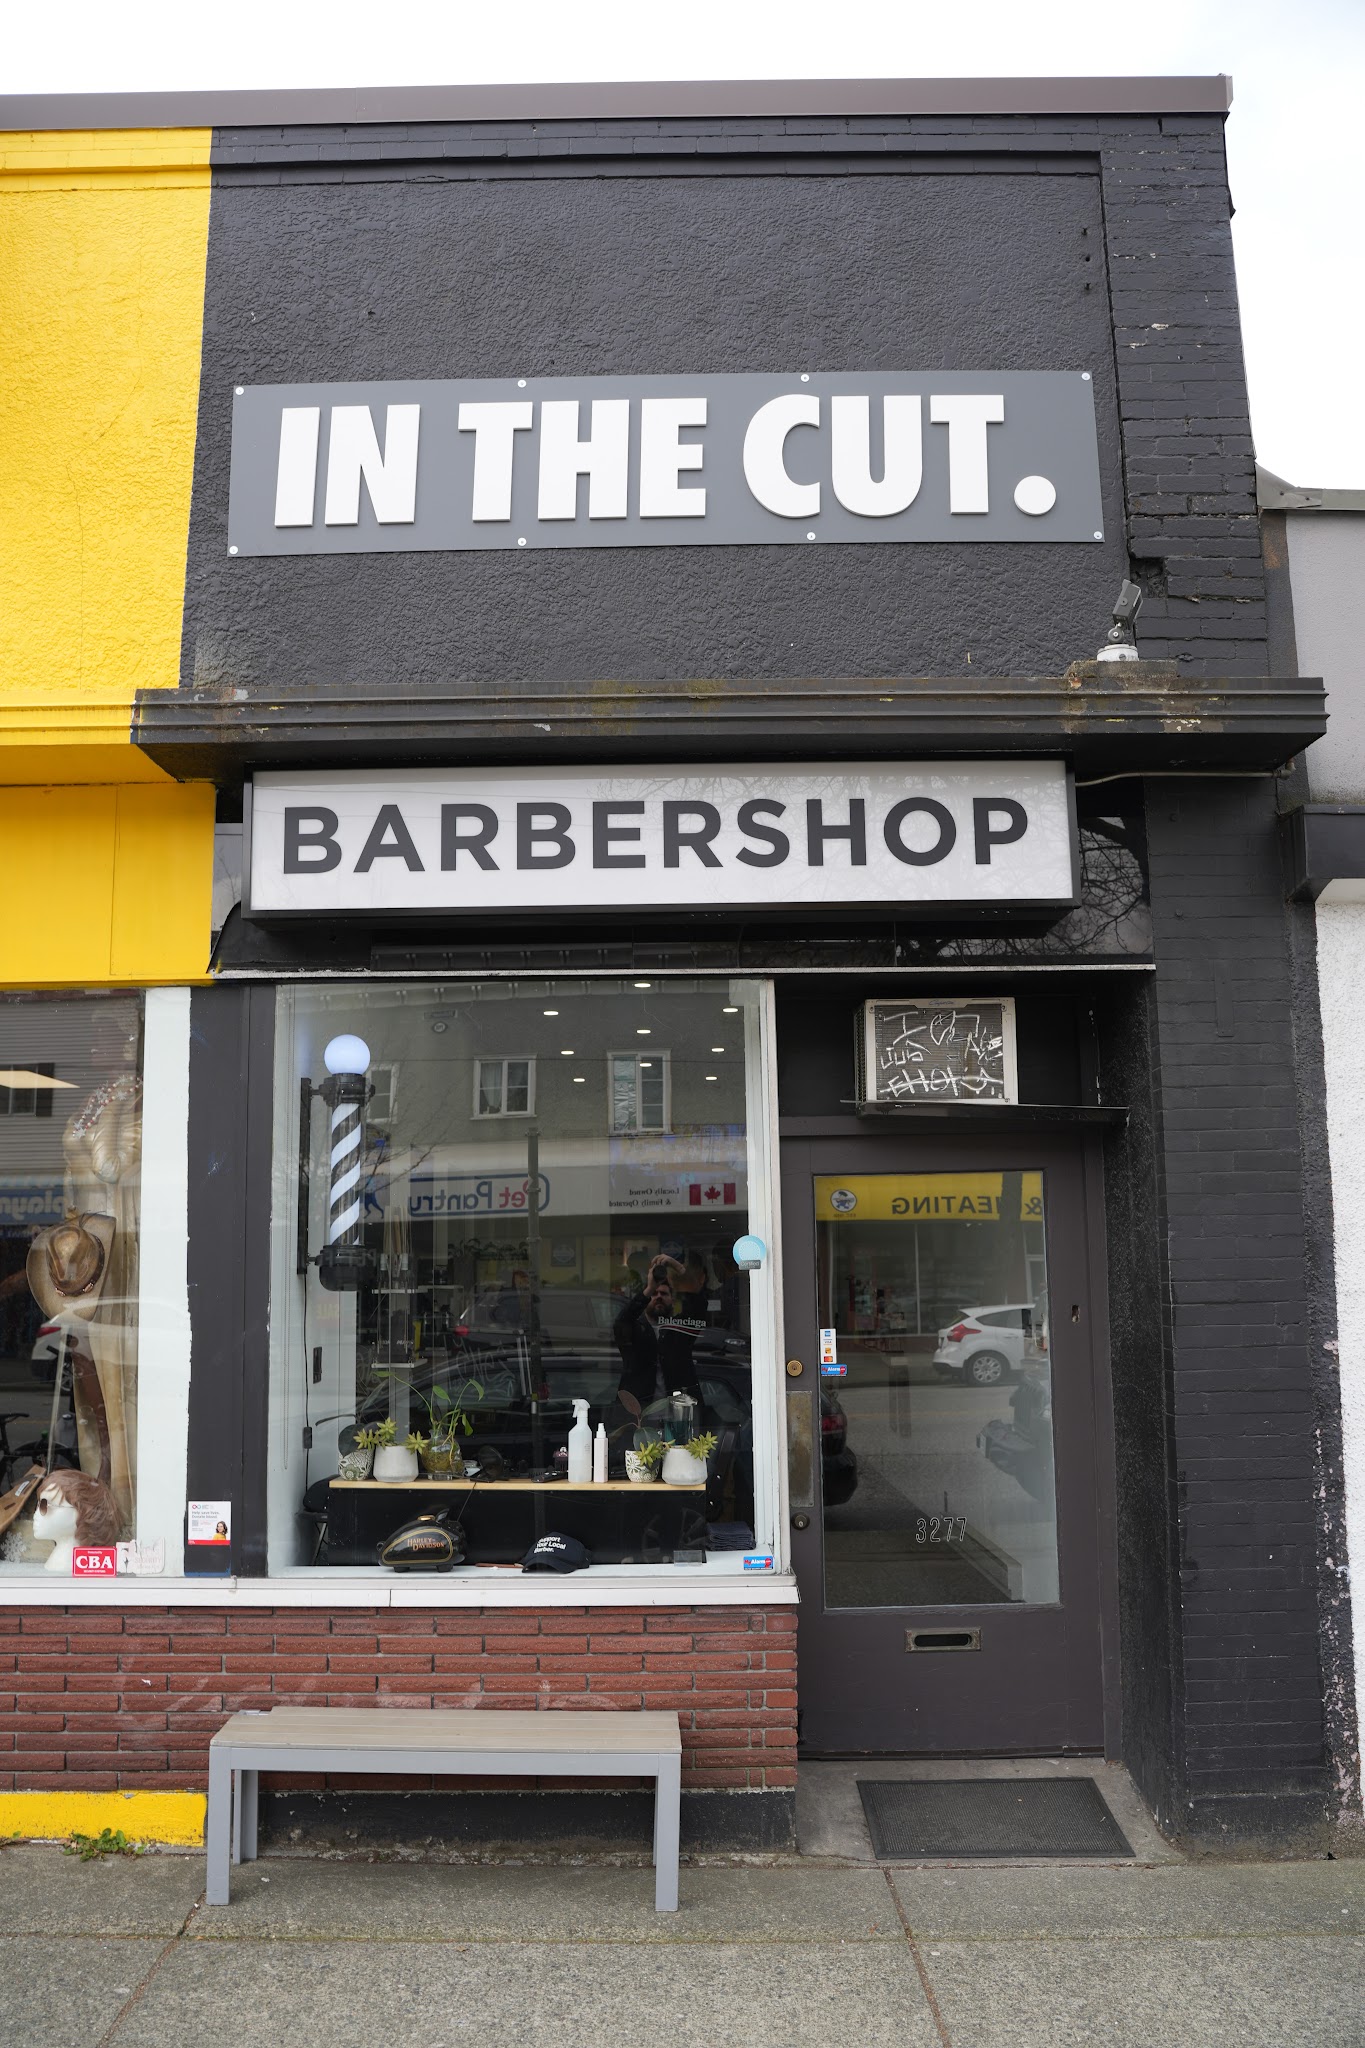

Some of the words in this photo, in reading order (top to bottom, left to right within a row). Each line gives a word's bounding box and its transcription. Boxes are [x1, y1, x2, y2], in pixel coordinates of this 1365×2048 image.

[274, 404, 421, 528] IN
[458, 397, 708, 523] THE
[742, 394, 1057, 518] CUT.
[283, 796, 1029, 875] BARBERSHOP
[657, 1316, 707, 1328] Balenciaga
[915, 1517, 967, 1543] 3277
[548, 1541, 567, 1550] Local
[75, 1555, 113, 1569] CBA
